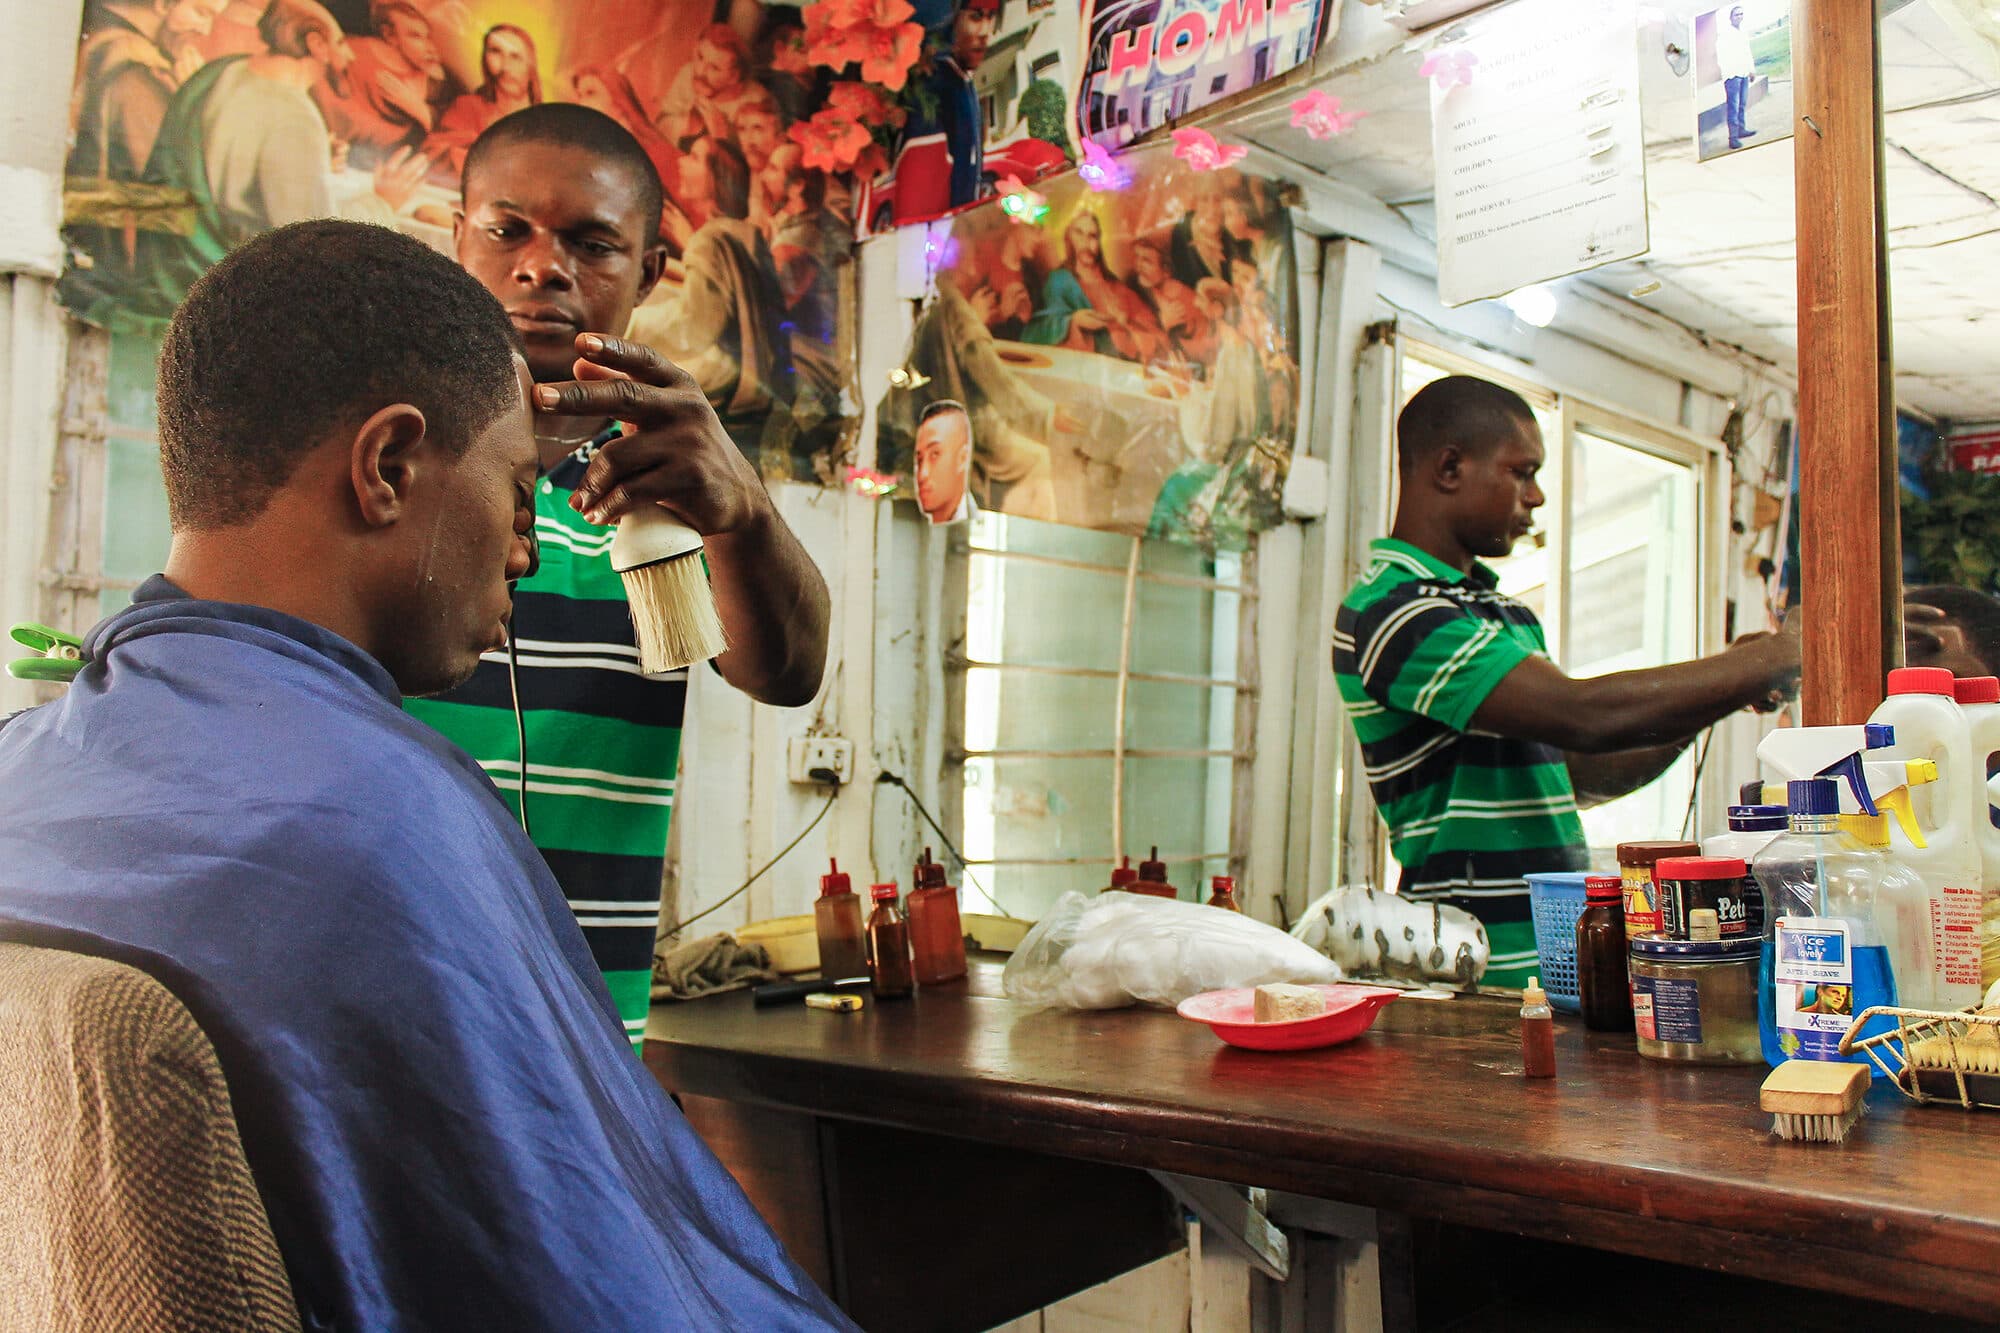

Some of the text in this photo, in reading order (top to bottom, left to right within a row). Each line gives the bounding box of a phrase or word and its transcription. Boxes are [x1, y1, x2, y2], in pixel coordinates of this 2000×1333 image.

[1453, 117, 1477, 131] ADULT
[1453, 133, 1497, 153] TEENAGERS
[1453, 158, 1493, 176] CHILDREN
[1455, 183, 1488, 198] SHAVING
[1455, 198, 1511, 221] HOME SERVICE
[1791, 933, 1825, 946] Nice
[1797, 947, 1823, 960] lovely
[1786, 968, 1840, 978] AFTER SHAVE
